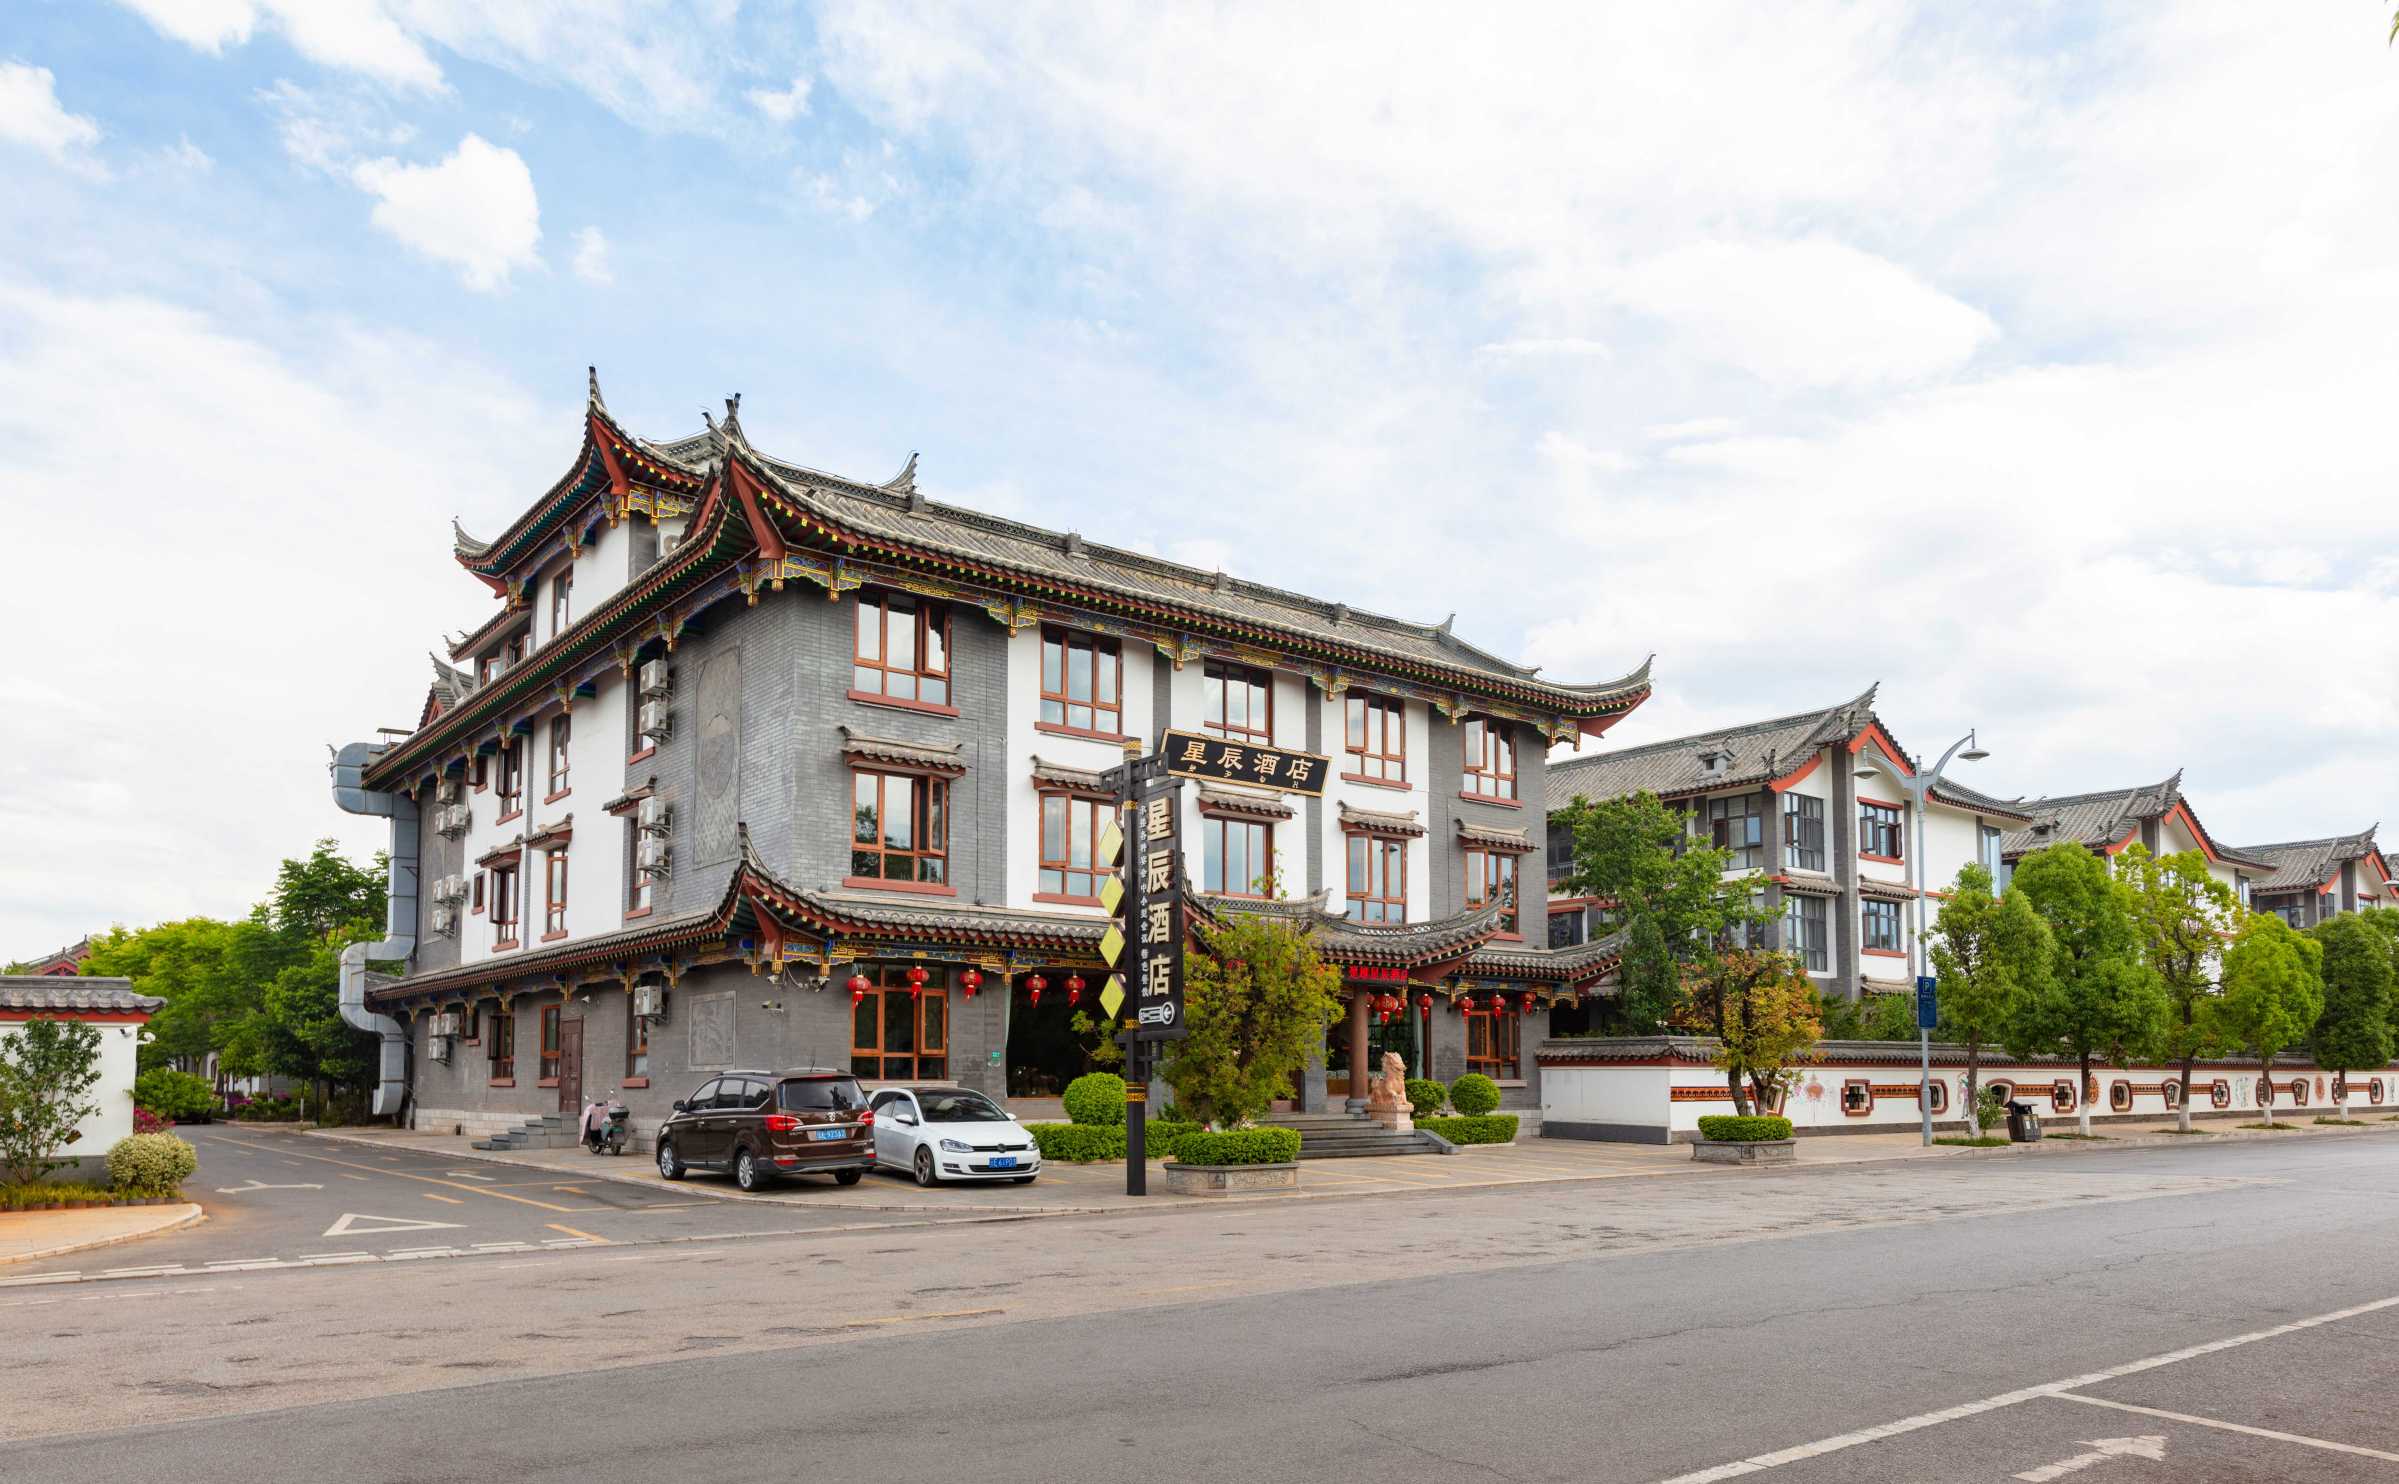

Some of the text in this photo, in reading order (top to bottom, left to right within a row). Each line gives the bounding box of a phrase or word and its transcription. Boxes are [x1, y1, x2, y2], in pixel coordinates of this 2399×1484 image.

[1180, 740, 1315, 782] 星辰酒店
[1147, 797, 1173, 996] 星辰酒店
